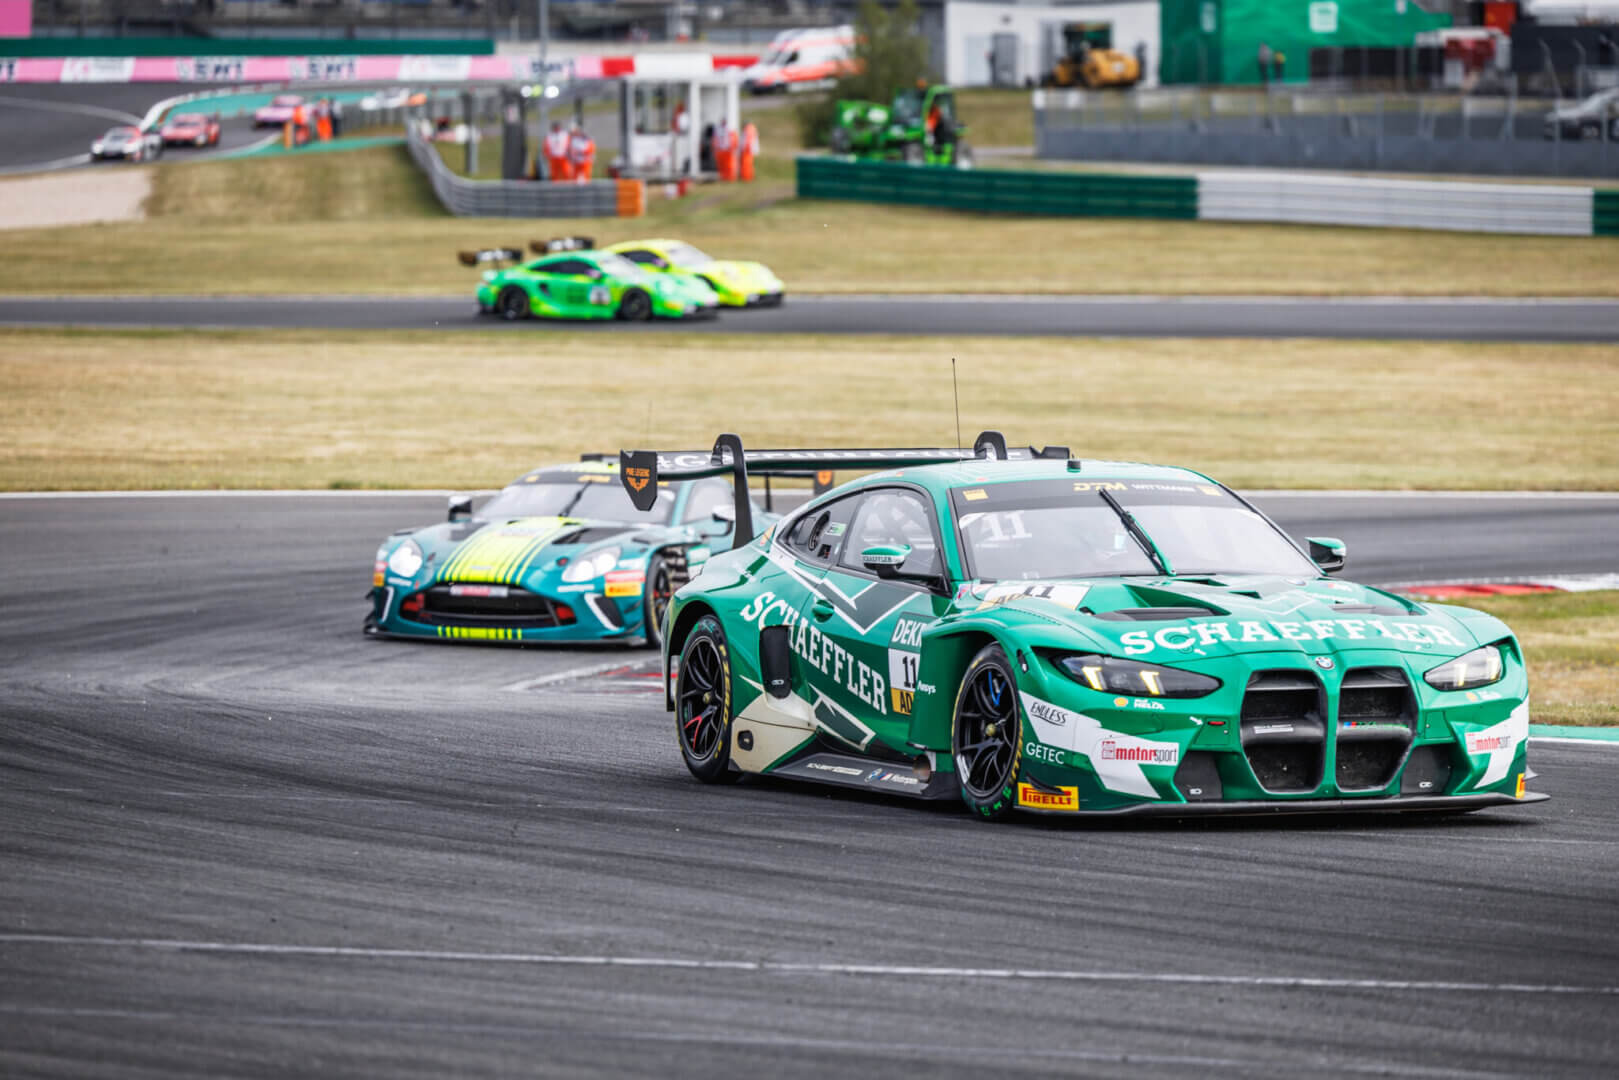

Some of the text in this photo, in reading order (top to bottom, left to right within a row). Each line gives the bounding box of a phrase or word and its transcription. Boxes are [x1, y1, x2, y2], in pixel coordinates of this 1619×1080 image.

[1073, 482, 1128, 491] DTM
[980, 510, 1032, 541] 11
[1023, 585, 1055, 599] 11
[1120, 619, 1466, 655] SCHAEFFLER
[740, 591, 887, 715] SCHAEFFLER
[902, 656, 916, 688] 11
[1030, 702, 1068, 724] ENDLESS
[1026, 742, 1065, 764] GETEC
[1115, 746, 1177, 763] motorsport
[1022, 787, 1072, 805] PIRELLI
